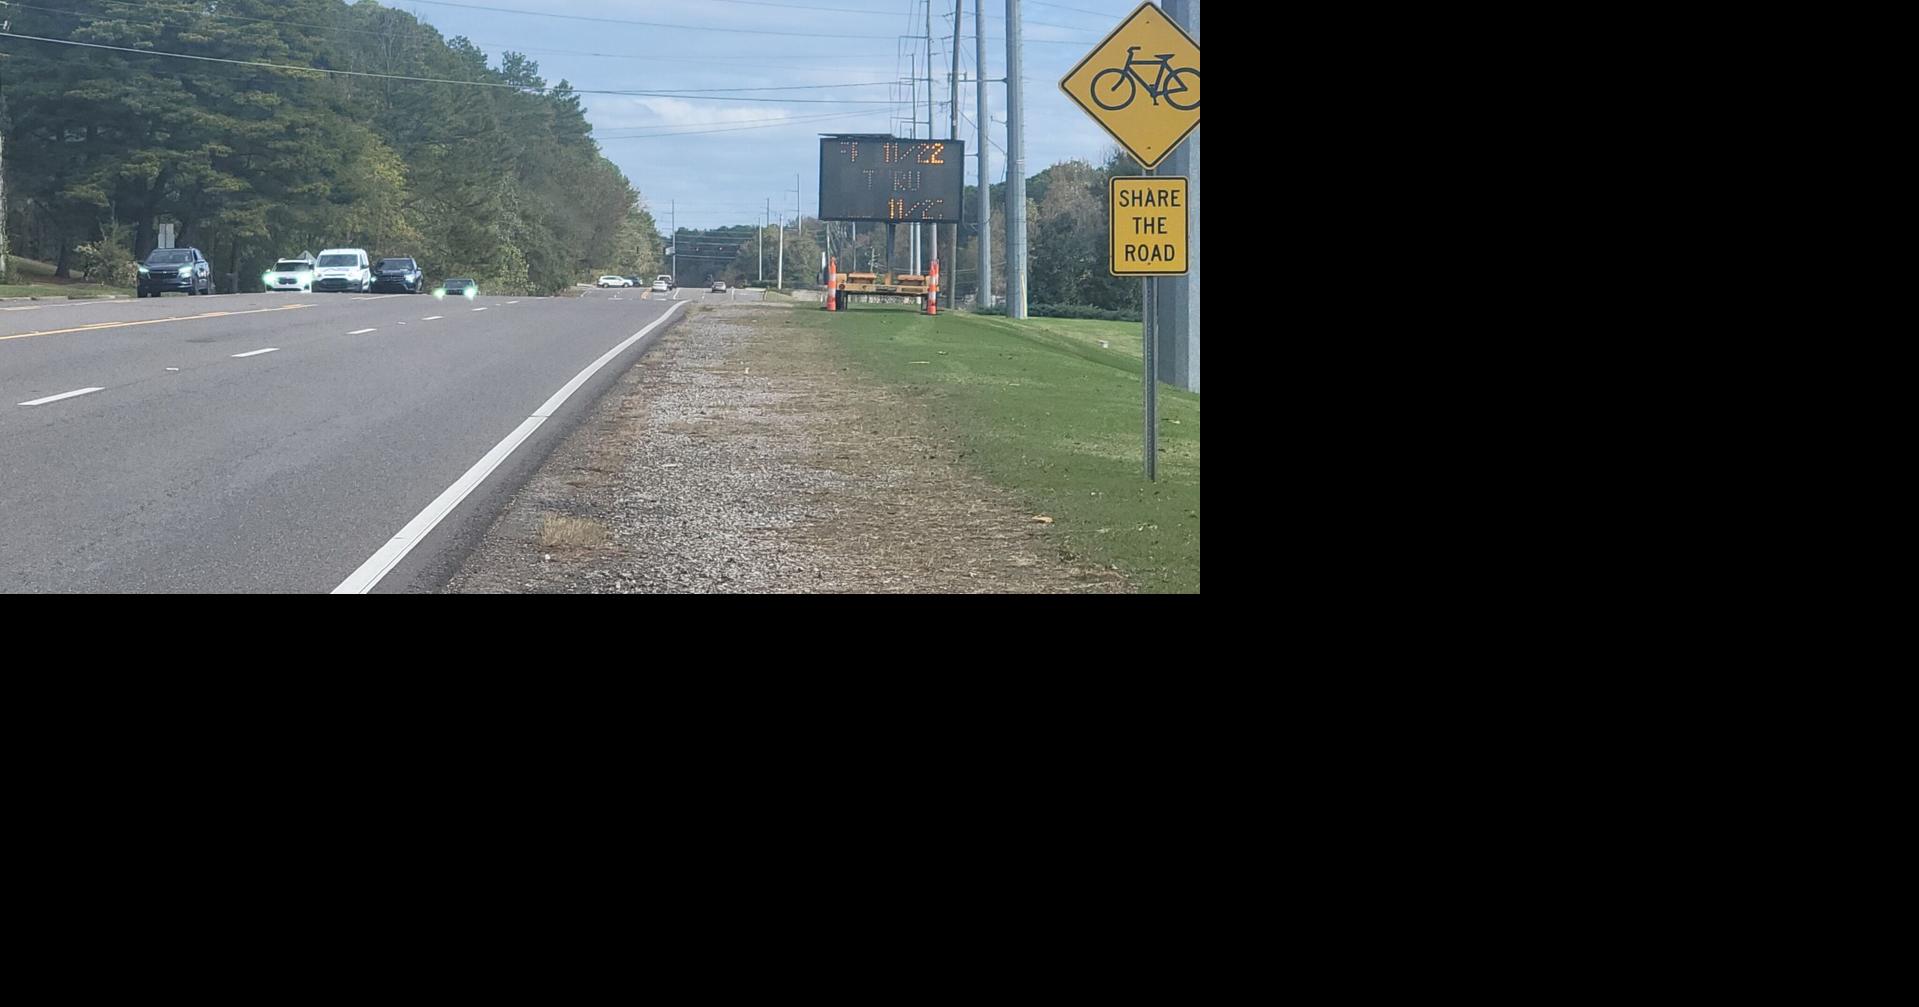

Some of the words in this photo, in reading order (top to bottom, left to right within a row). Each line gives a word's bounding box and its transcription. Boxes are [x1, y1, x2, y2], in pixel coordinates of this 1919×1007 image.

[883, 142, 944, 164] 11/22
[862, 169, 921, 192] TRU
[1119, 189, 1181, 207] SHARE
[887, 198, 943, 220] 11/2
[1132, 216, 1168, 234] THE
[1125, 244, 1175, 262] ROAD
